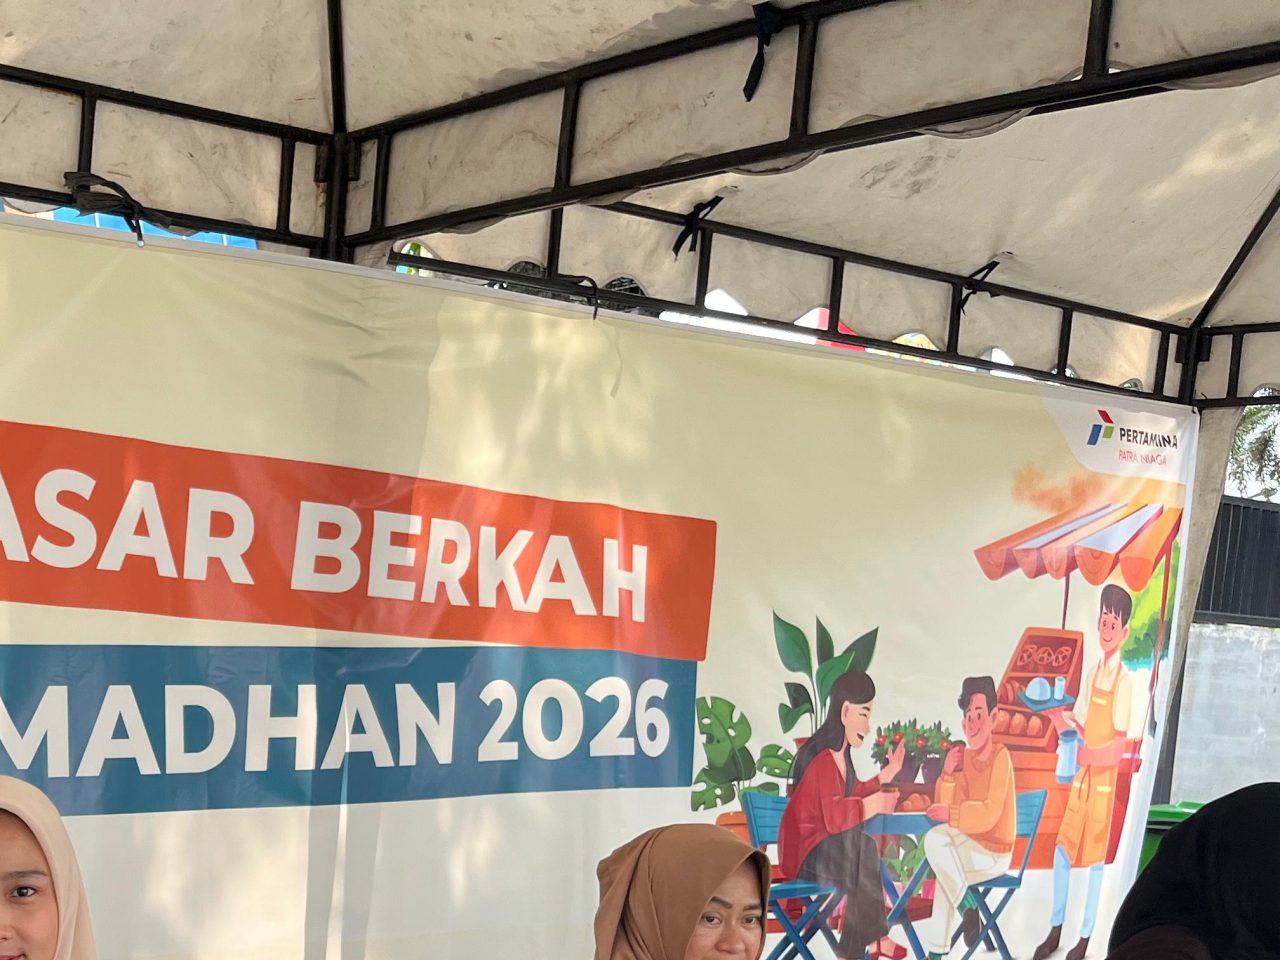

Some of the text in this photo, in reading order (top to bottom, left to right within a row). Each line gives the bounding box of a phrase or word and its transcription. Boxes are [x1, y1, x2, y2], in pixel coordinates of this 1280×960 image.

[1119, 427, 1178, 449] PERTAMINA
[1140, 453, 1167, 465] NIAGA
[290, 501, 650, 624] BERKAH
[478, 676, 671, 761] 2026
